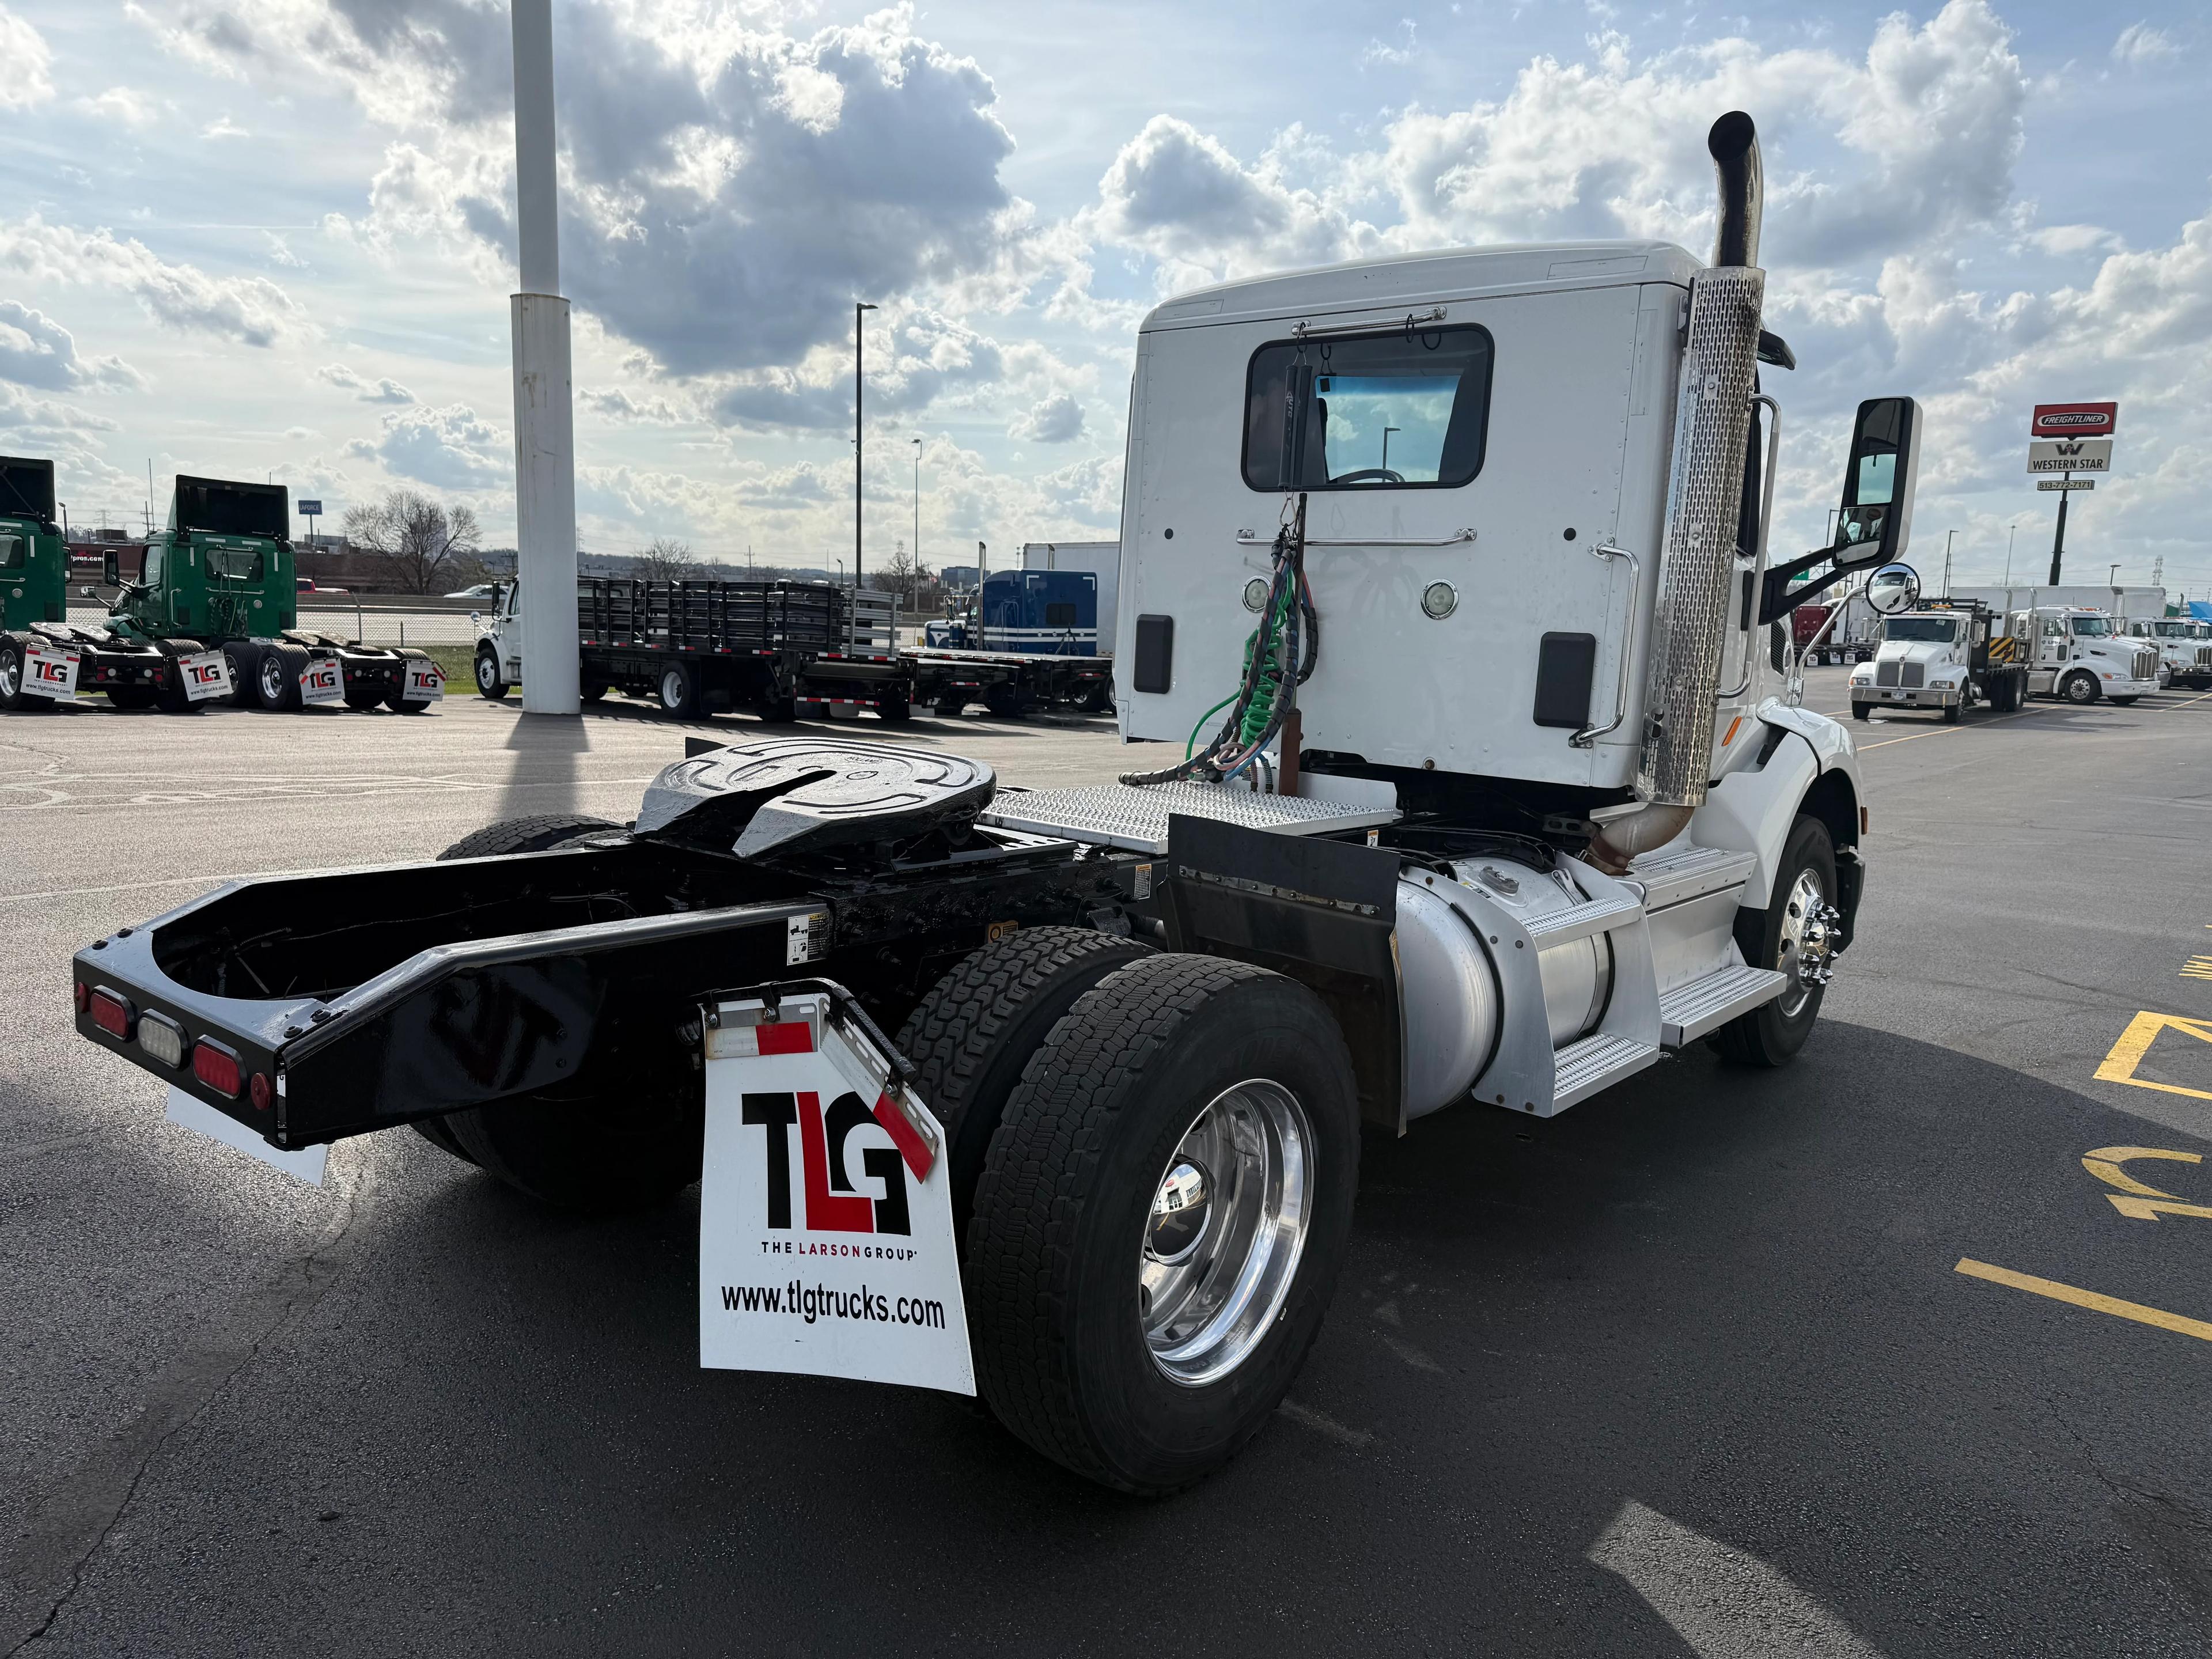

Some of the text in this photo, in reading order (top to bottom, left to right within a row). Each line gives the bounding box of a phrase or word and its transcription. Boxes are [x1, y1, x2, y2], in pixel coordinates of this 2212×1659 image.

[2044, 415, 2103, 424] FREIGHTLINER
[2033, 459, 2103, 470] WESTERN STAR
[33, 660, 68, 683] TLG
[188, 665, 221, 684] TLG
[310, 672, 336, 688] TLG
[412, 672, 438, 688] TLG
[26, 683, 71, 695] www.tlgtrucks.com
[191, 685, 229, 695] www.tlgtrucks.com
[741, 1090, 911, 1236] TLG
[762, 1241, 915, 1261] THE LARSON GROUP
[721, 1279, 946, 1330] www.tlgtrucks.com
